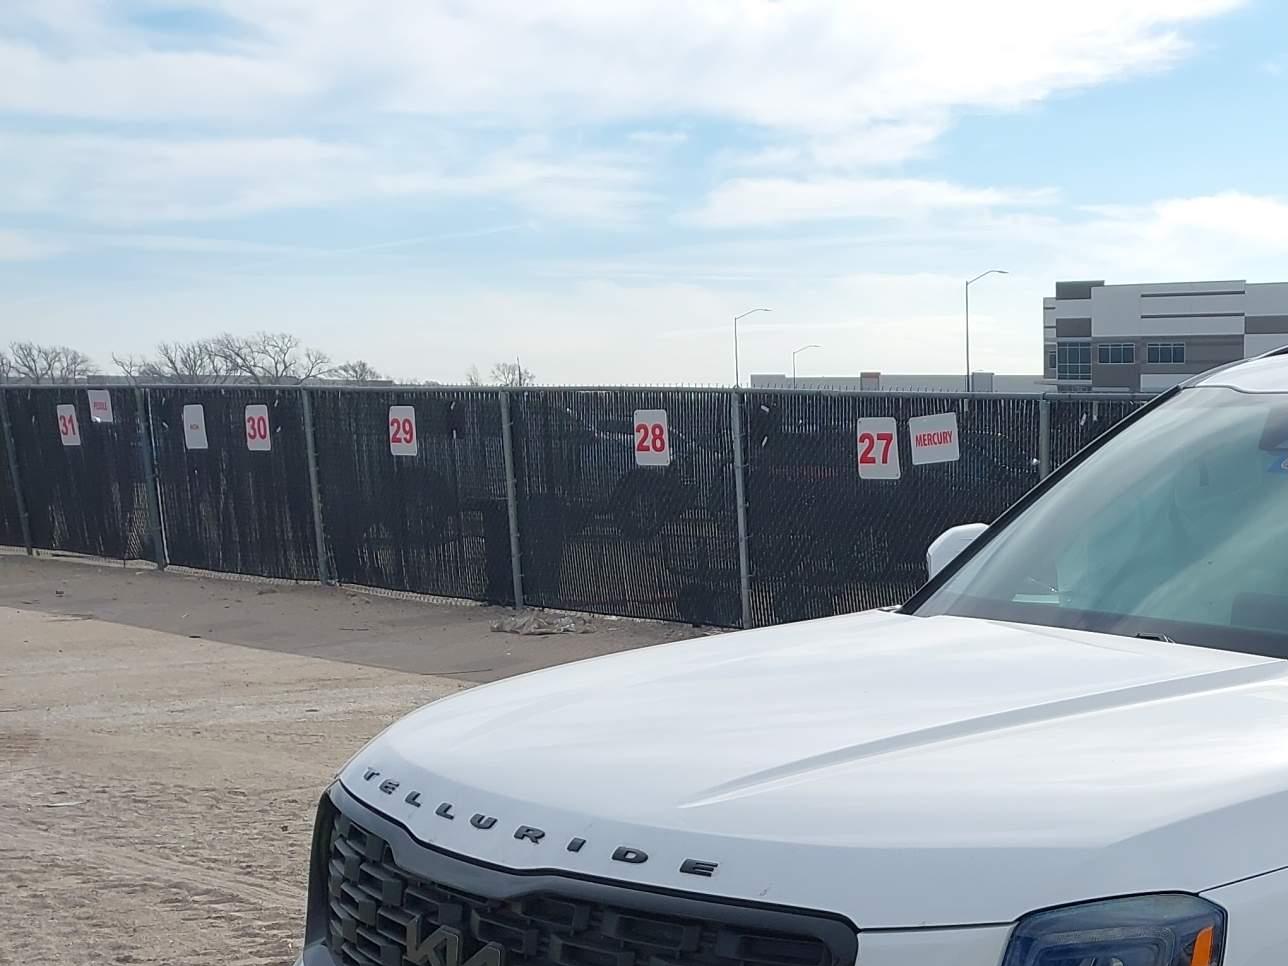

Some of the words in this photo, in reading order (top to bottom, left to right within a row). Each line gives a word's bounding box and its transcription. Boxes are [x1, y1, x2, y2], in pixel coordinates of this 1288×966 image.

[60, 415, 76, 436] 31
[247, 416, 267, 440] 30
[390, 418, 414, 444] 29
[635, 424, 665, 452] 28
[858, 432, 894, 465] 27
[915, 430, 953, 448] MERCURY
[362, 767, 721, 878] TELLURIDE
